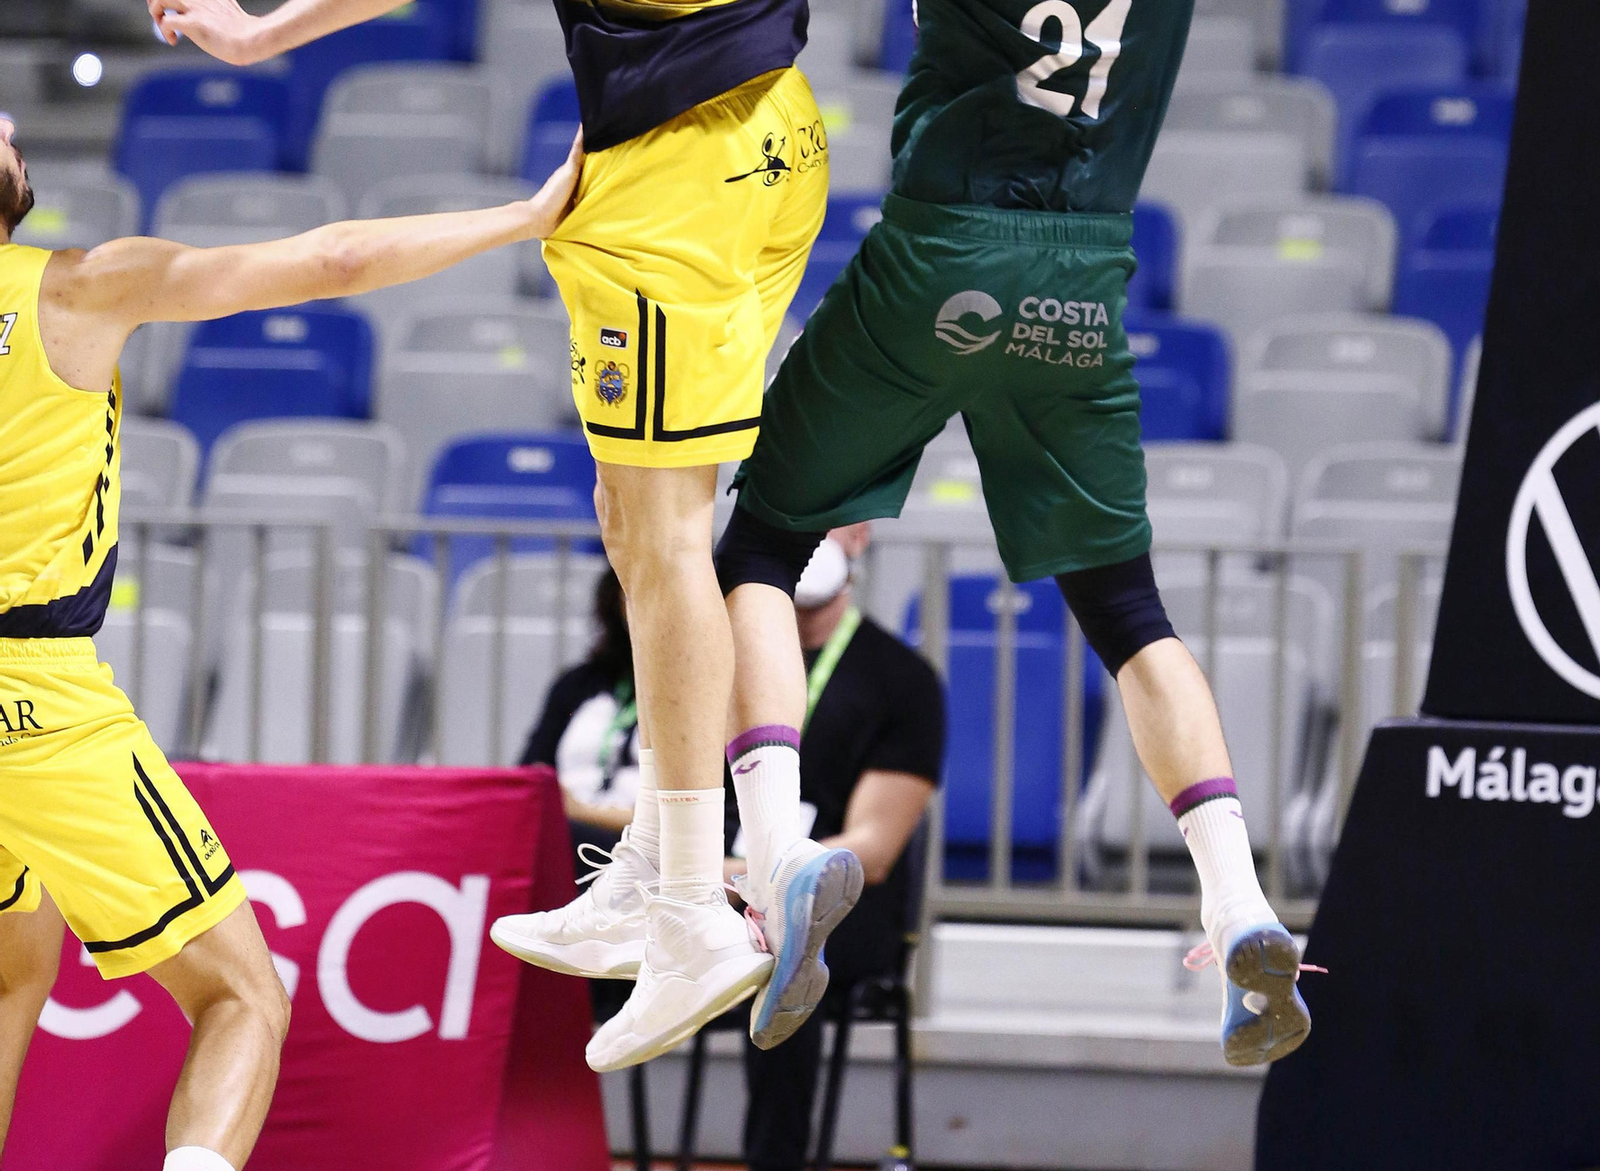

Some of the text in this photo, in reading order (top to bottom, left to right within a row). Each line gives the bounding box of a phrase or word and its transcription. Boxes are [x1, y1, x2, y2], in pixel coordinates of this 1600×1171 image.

[1018, 296, 1110, 326] COSTA
[601, 335, 622, 347] acb
[1012, 322, 1108, 349] DEL SOL
[1005, 342, 1104, 369] MÁLAGA
[1425, 745, 1600, 819] Málag
